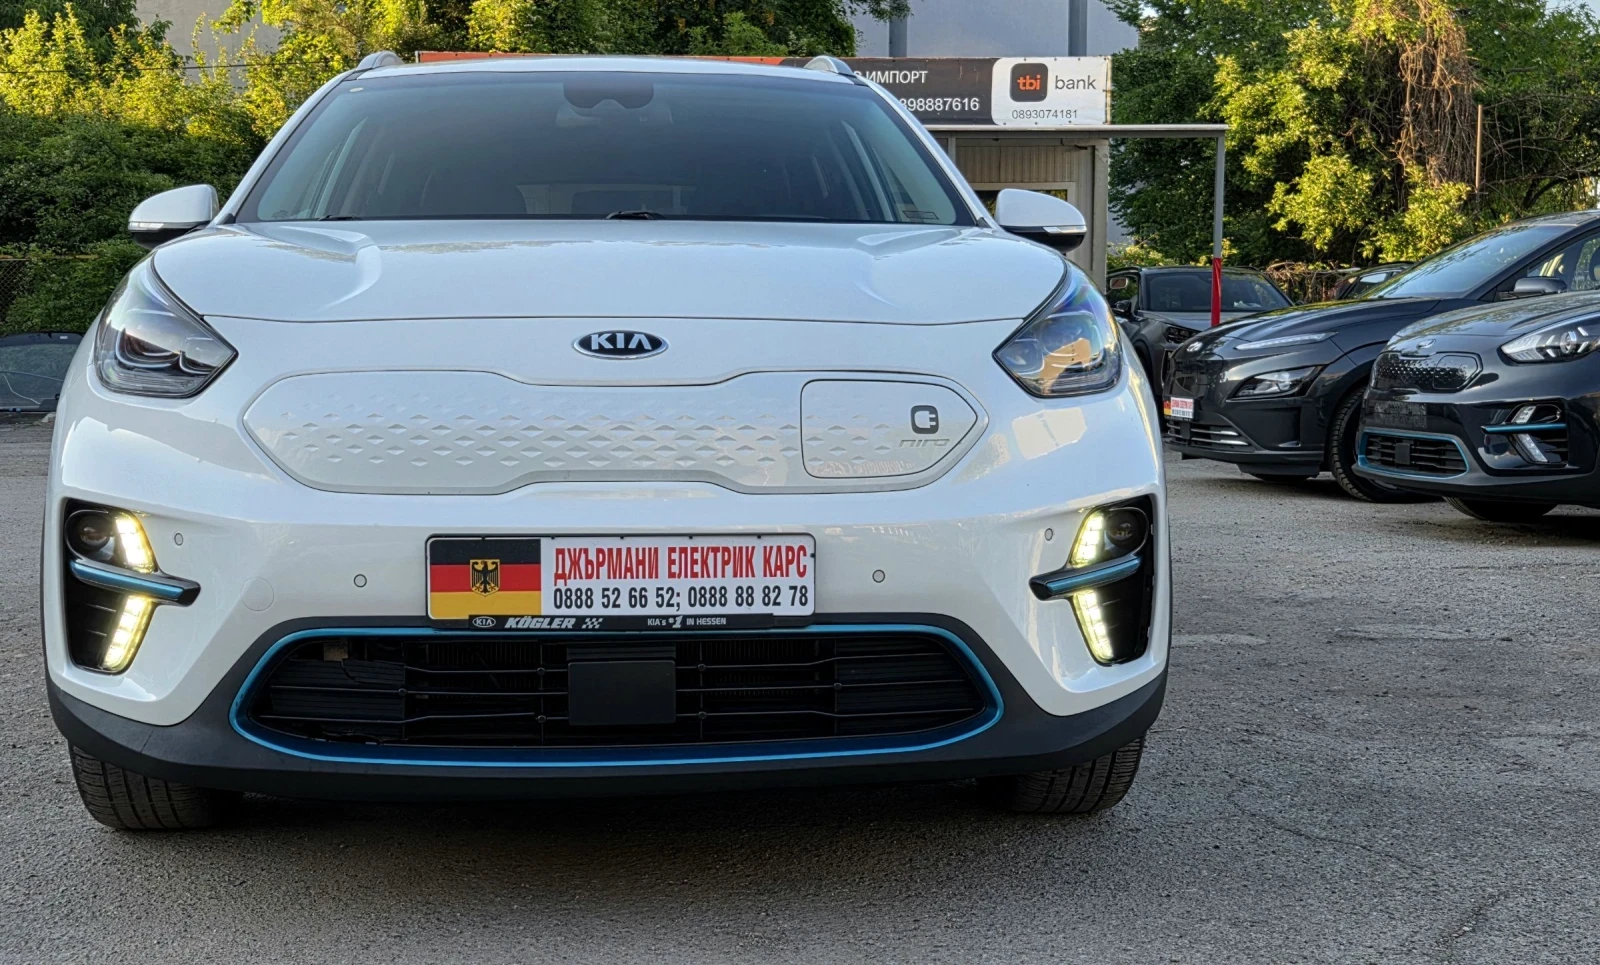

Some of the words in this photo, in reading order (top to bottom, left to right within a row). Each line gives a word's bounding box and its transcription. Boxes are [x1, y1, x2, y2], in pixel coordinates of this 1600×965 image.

[866, 70, 928, 84] ИМПОРТ
[1017, 74, 1041, 91] tbi
[1055, 75, 1096, 90] bank
[1011, 108, 1078, 119] 0893074181
[590, 332, 652, 351] KIA
[553, 547, 659, 587] ДЖЪРМАНИ
[667, 545, 756, 579] ЕЛЕКТРИК
[763, 544, 808, 578] КАРС
[553, 587, 594, 609] 0888
[601, 587, 621, 609] 52
[628, 586, 648, 608] 66
[655, 586, 681, 611] 52;
[688, 585, 728, 608] 0888
[735, 585, 755, 607] 88
[762, 584, 782, 607] 82
[789, 584, 809, 607] 78
[504, 616, 576, 629] KÖGLER
[696, 617, 727, 625] HESSEN
